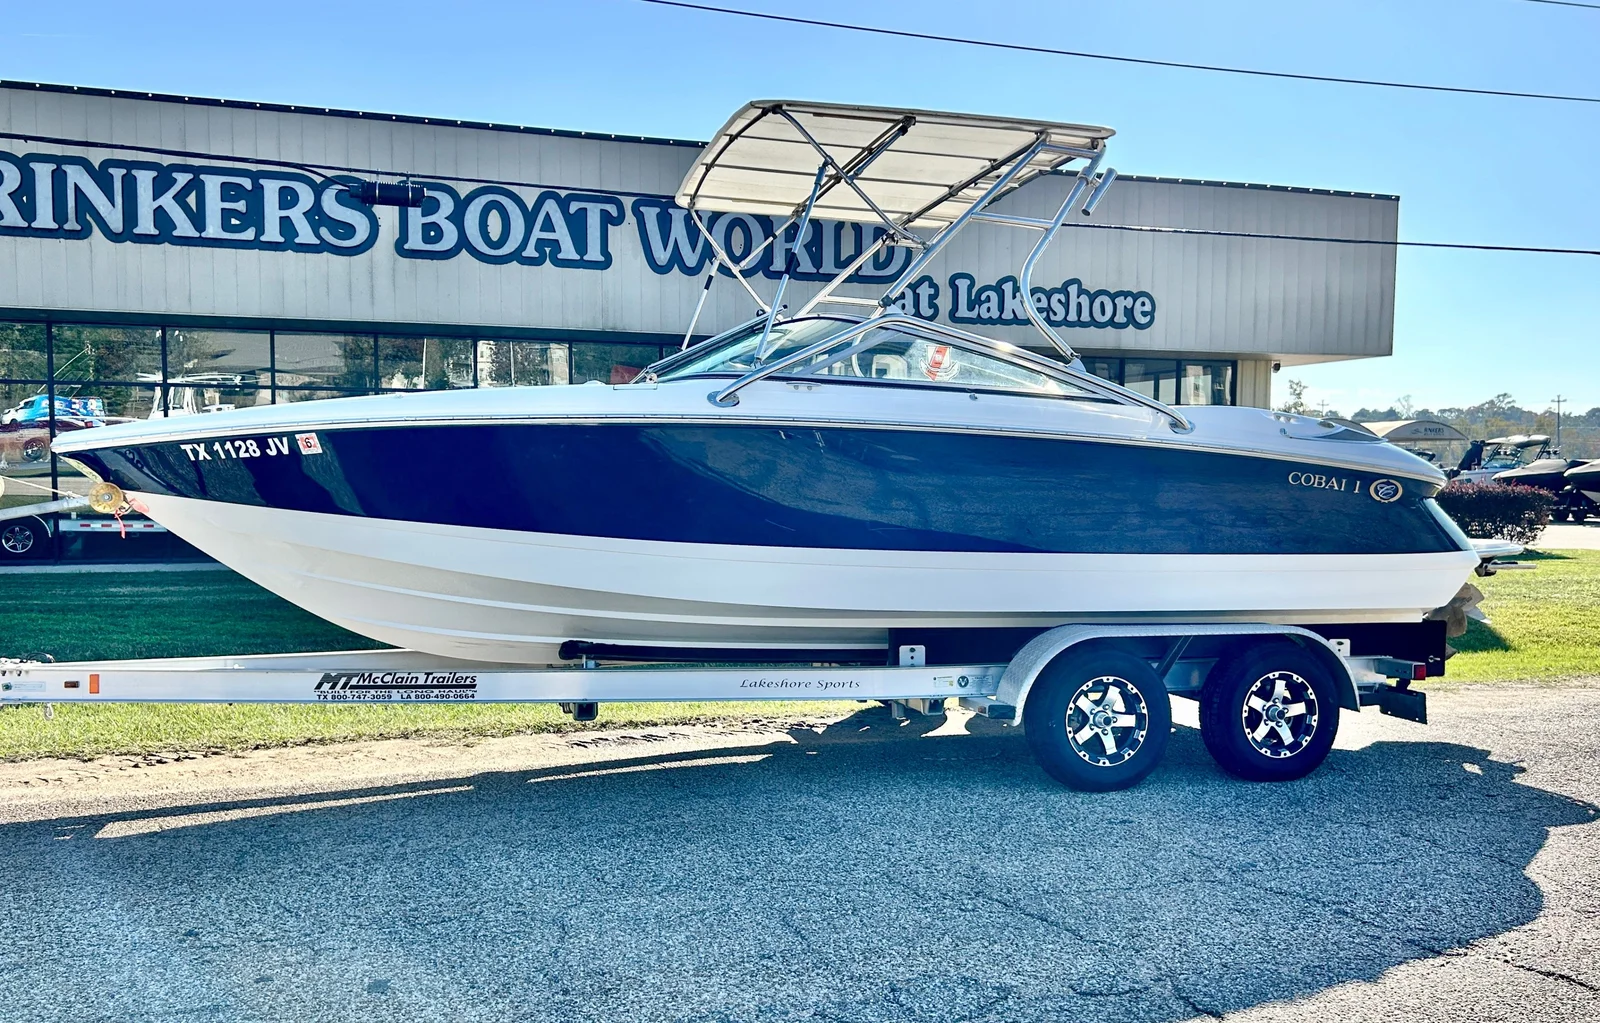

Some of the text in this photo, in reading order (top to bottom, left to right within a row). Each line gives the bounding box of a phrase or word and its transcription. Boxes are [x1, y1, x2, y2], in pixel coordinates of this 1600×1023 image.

[403, 190, 619, 262] BOAT
[639, 205, 907, 276] WORLD
[894, 278, 1152, 324] at Lakeshore
[180, 437, 289, 461] TX 1128 JV
[304, 437, 312, 449] 6
[356, 672, 419, 684] McClain
[424, 672, 477, 684] Trailers
[740, 678, 860, 691] Lakeshore Sports
